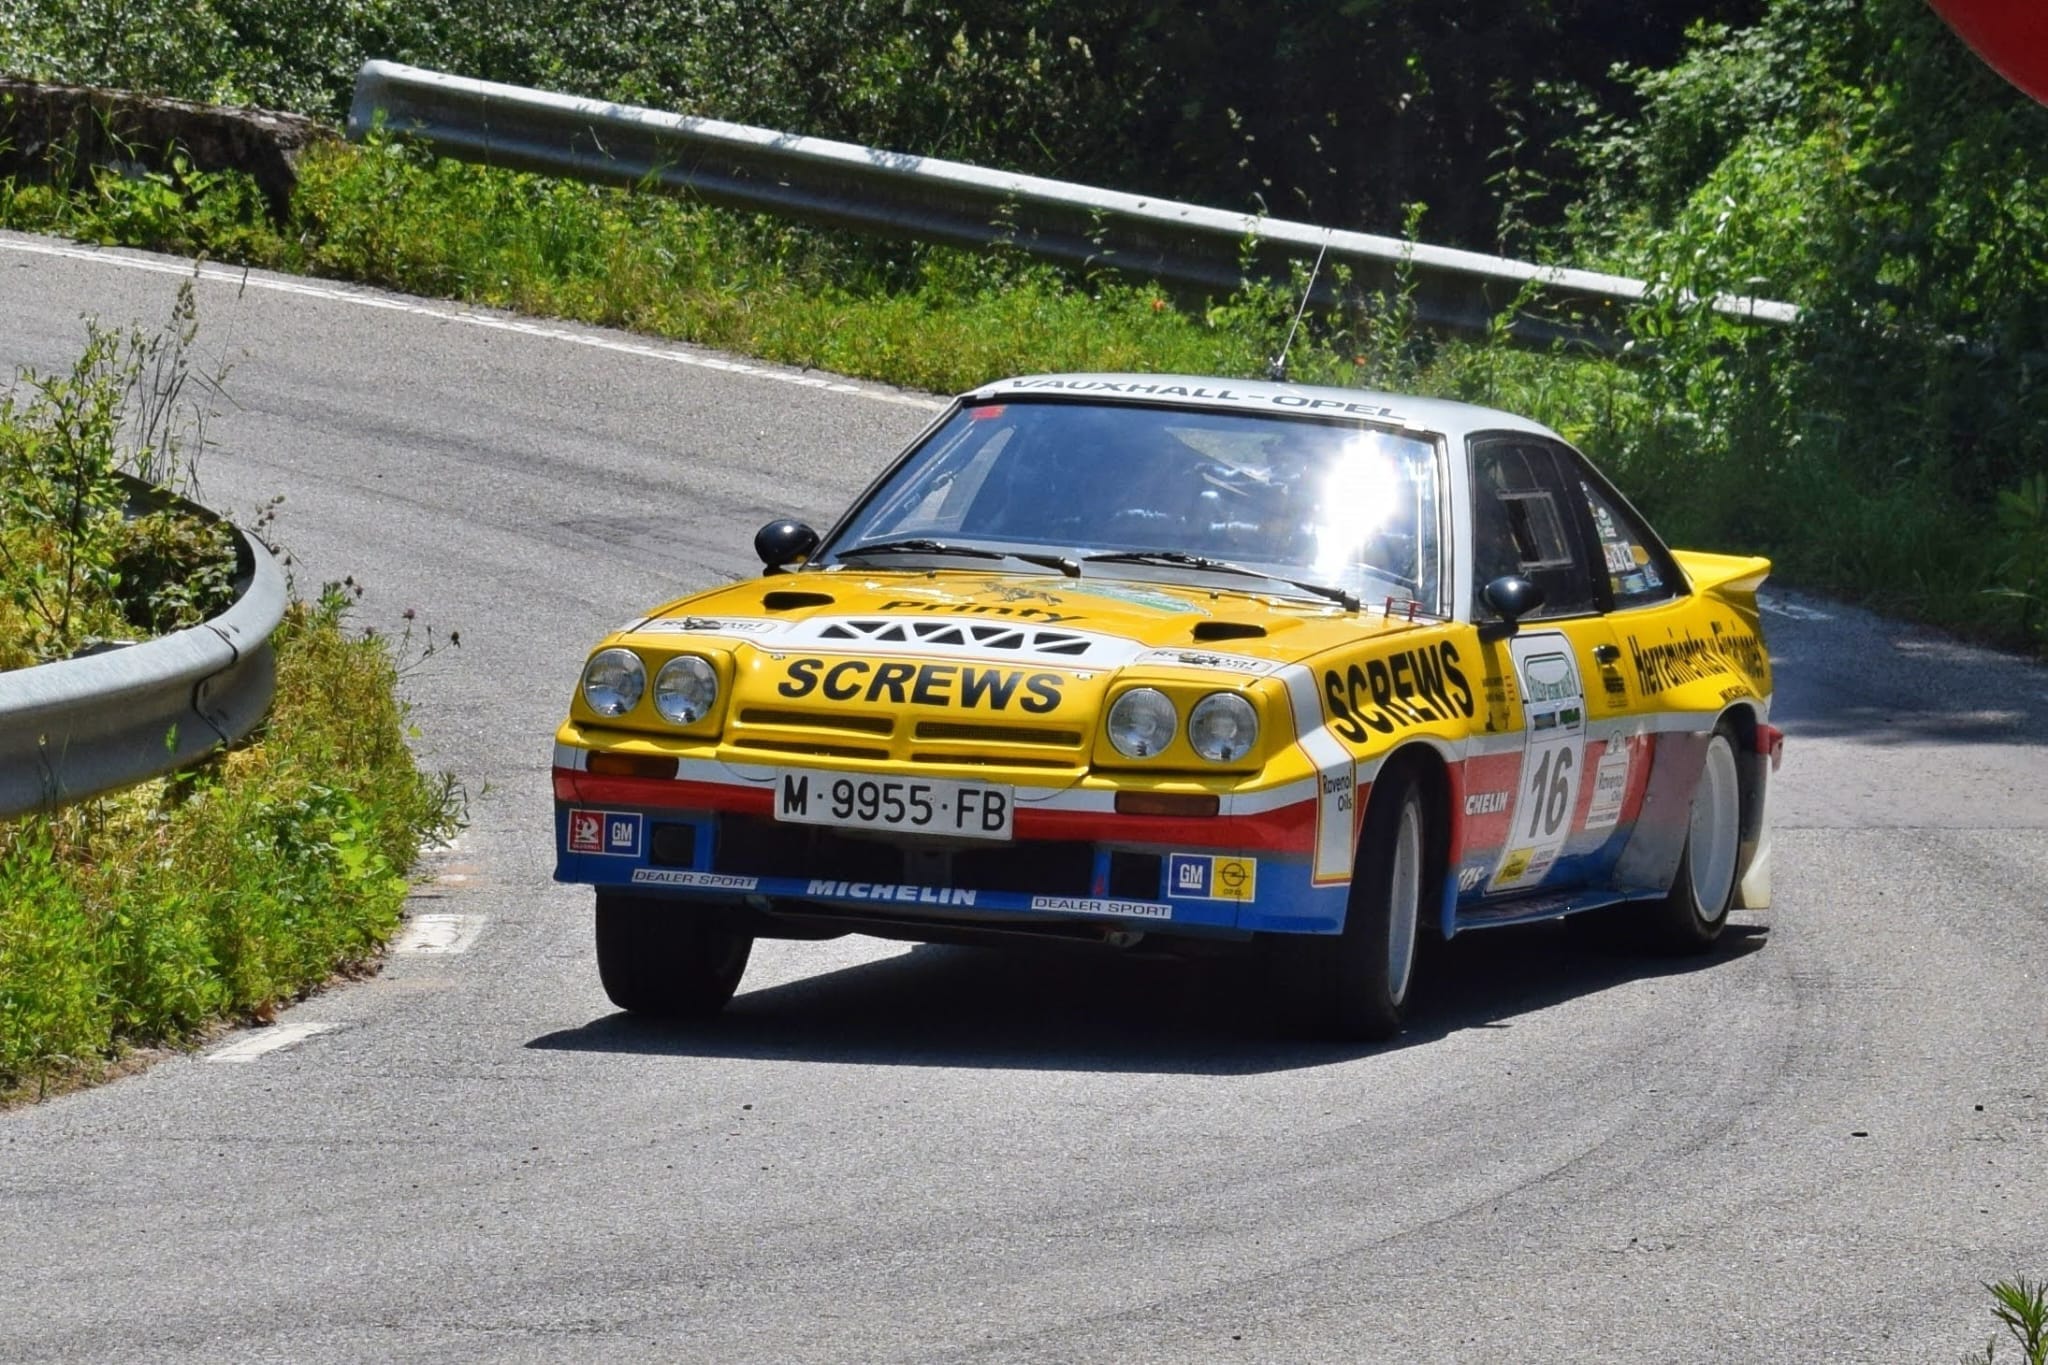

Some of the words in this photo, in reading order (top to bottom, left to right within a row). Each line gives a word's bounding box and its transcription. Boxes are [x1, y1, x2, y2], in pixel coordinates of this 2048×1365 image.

[778, 659, 1064, 713] SCREWS
[1325, 640, 1474, 743] SCREWS
[1464, 792, 1508, 815] CHELIN
[1529, 747, 1572, 838] 16
[612, 822, 632, 841] GM
[634, 871, 692, 884] DEALER
[700, 874, 756, 888] SPORT
[1180, 864, 1203, 883] GM
[806, 880, 977, 906] MICHELIN
[1034, 898, 1101, 911] DEALER
[1108, 903, 1169, 917] SPORT
